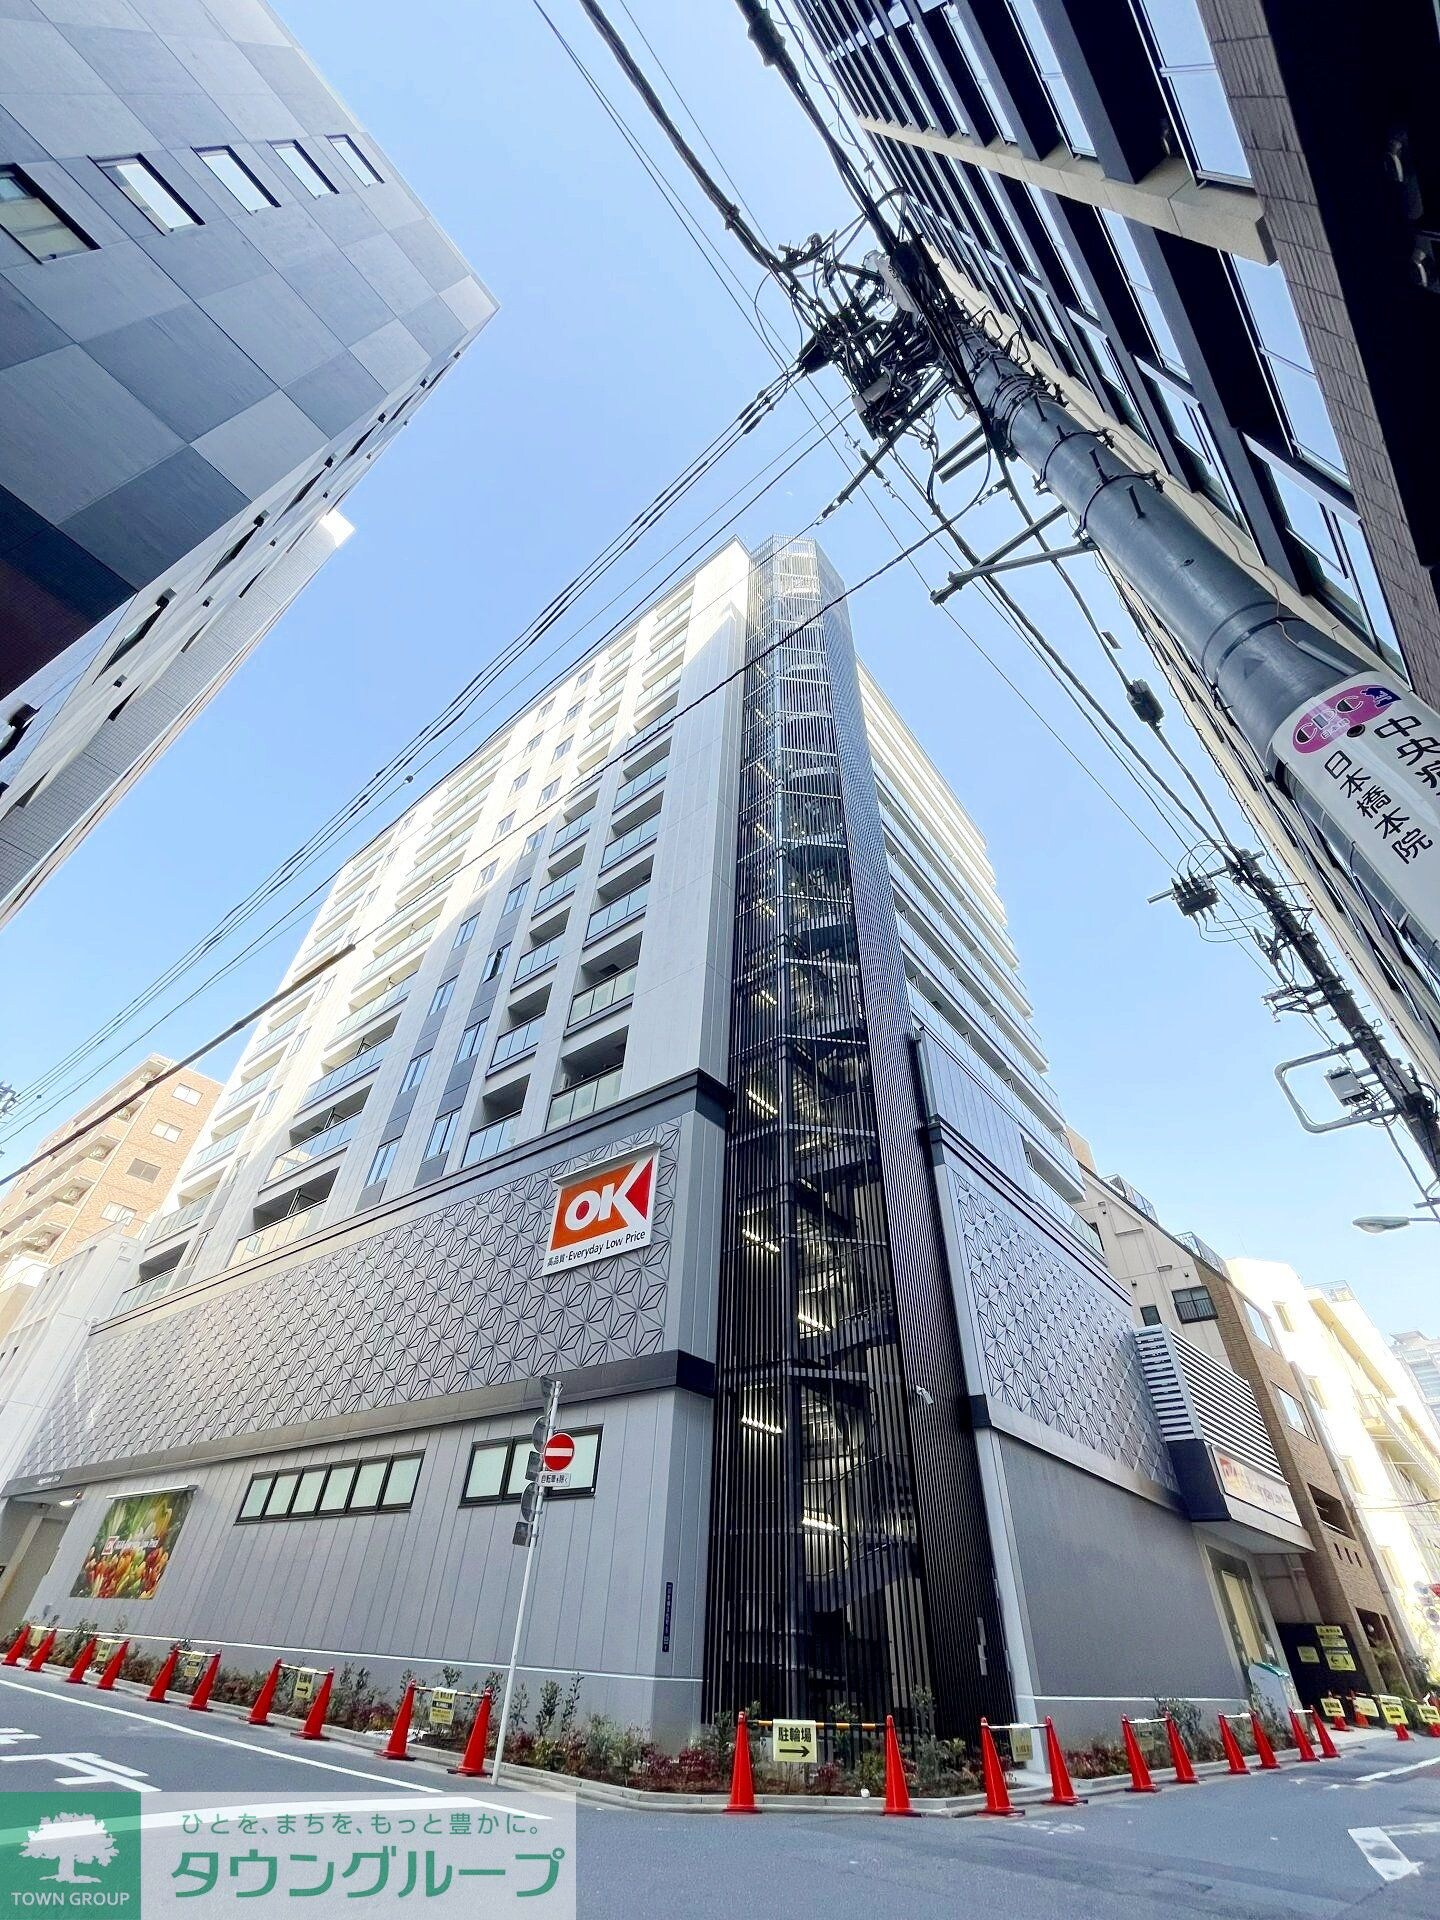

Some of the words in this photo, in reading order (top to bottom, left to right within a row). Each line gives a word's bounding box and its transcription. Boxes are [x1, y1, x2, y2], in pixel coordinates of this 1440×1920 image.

[1324, 750, 1433, 865] 日本橋本院
[565, 1157, 652, 1231] OK
[605, 1238, 624, 1250] Low
[625, 1230, 646, 1244] Price
[778, 1726, 812, 1743] 駐輪場
